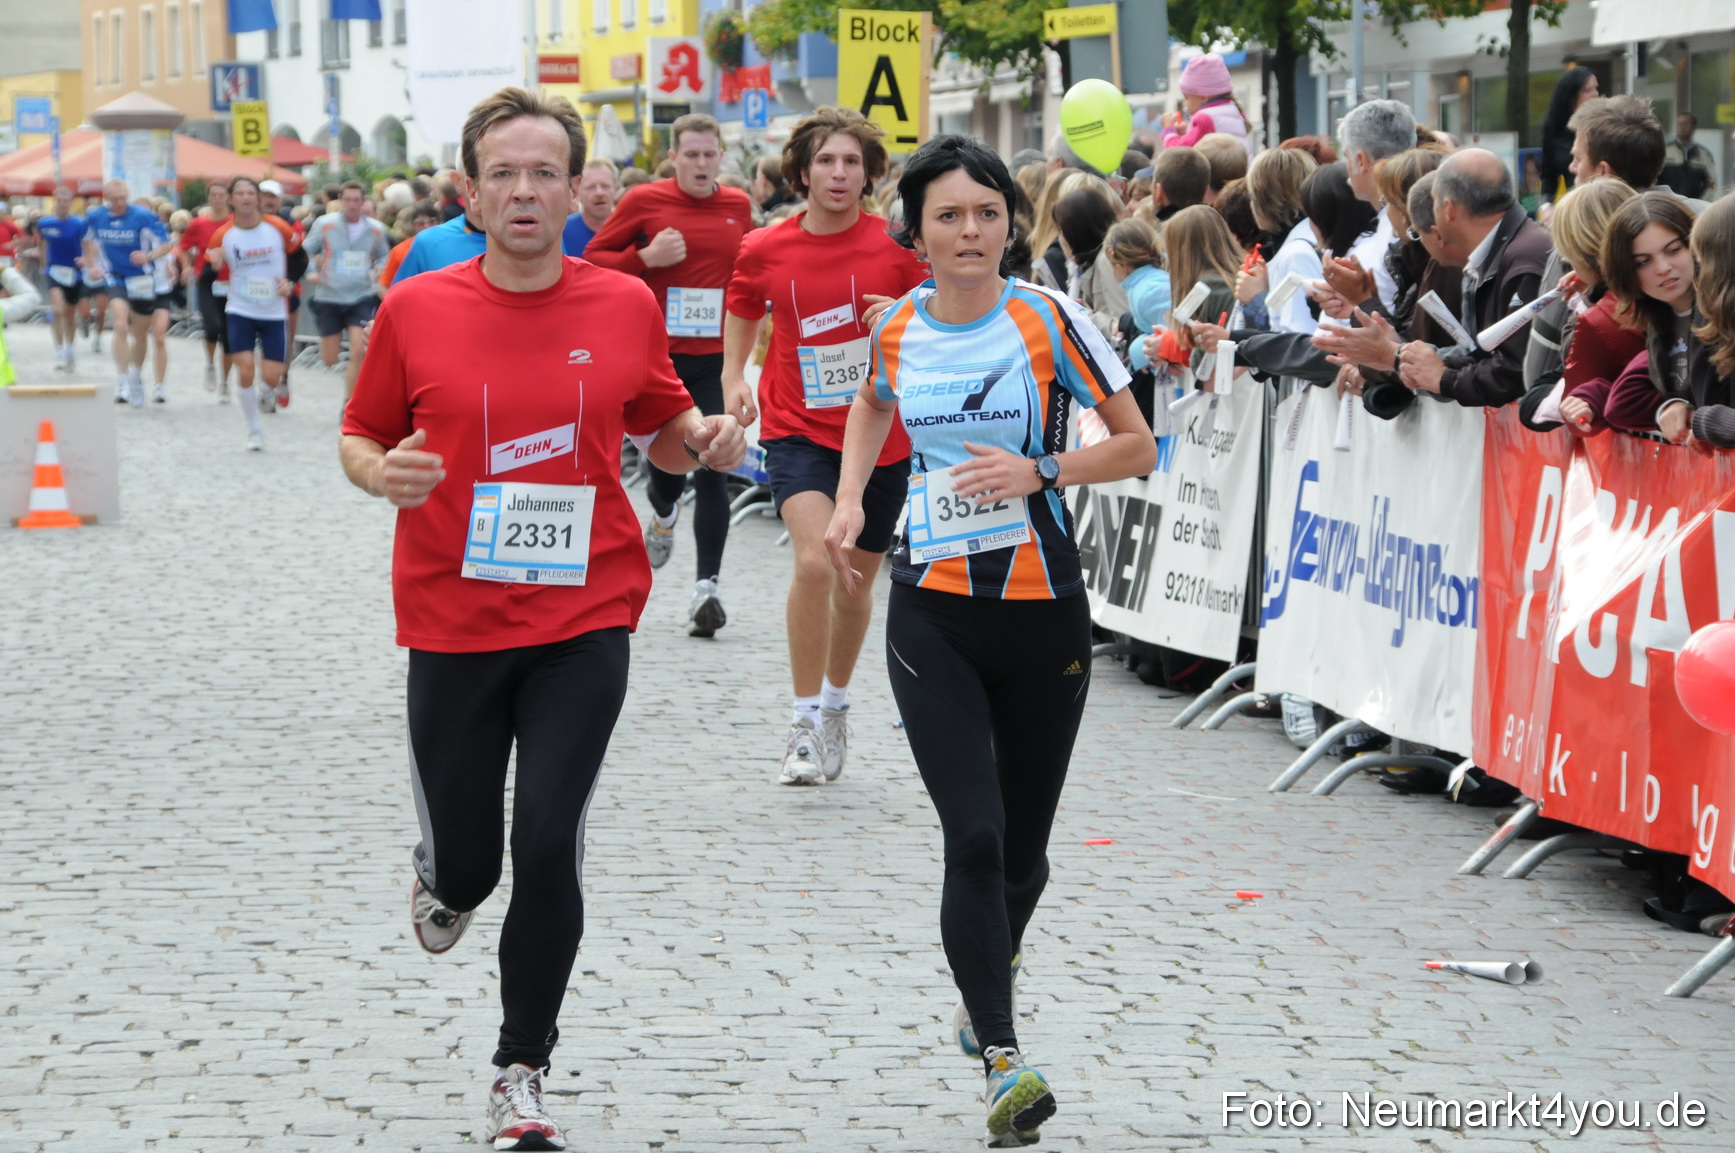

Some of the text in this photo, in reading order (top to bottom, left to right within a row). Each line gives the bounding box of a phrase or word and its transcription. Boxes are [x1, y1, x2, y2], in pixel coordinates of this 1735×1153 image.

[850, 16, 920, 42] Block
[1061, 15, 1106, 28] Toiletten
[859, 54, 909, 122] A
[243, 118, 262, 145] B
[684, 307, 716, 319] 2438
[816, 313, 840, 328] DEHN
[820, 349, 846, 363] Josef
[903, 379, 985, 400] SPEED
[905, 409, 1021, 428] RACING TEAM
[513, 438, 552, 460] DEHN
[1178, 473, 1197, 504] Im
[507, 493, 575, 512] Johannes
[477, 518, 485, 531] B
[1172, 513, 1199, 544] der
[504, 523, 573, 549] 2331
[980, 528, 1027, 546] PFLEIDERER
[1074, 484, 1163, 614] AYER
[539, 570, 585, 579] PFLEIDERER
[1165, 571, 1205, 606] 92318
